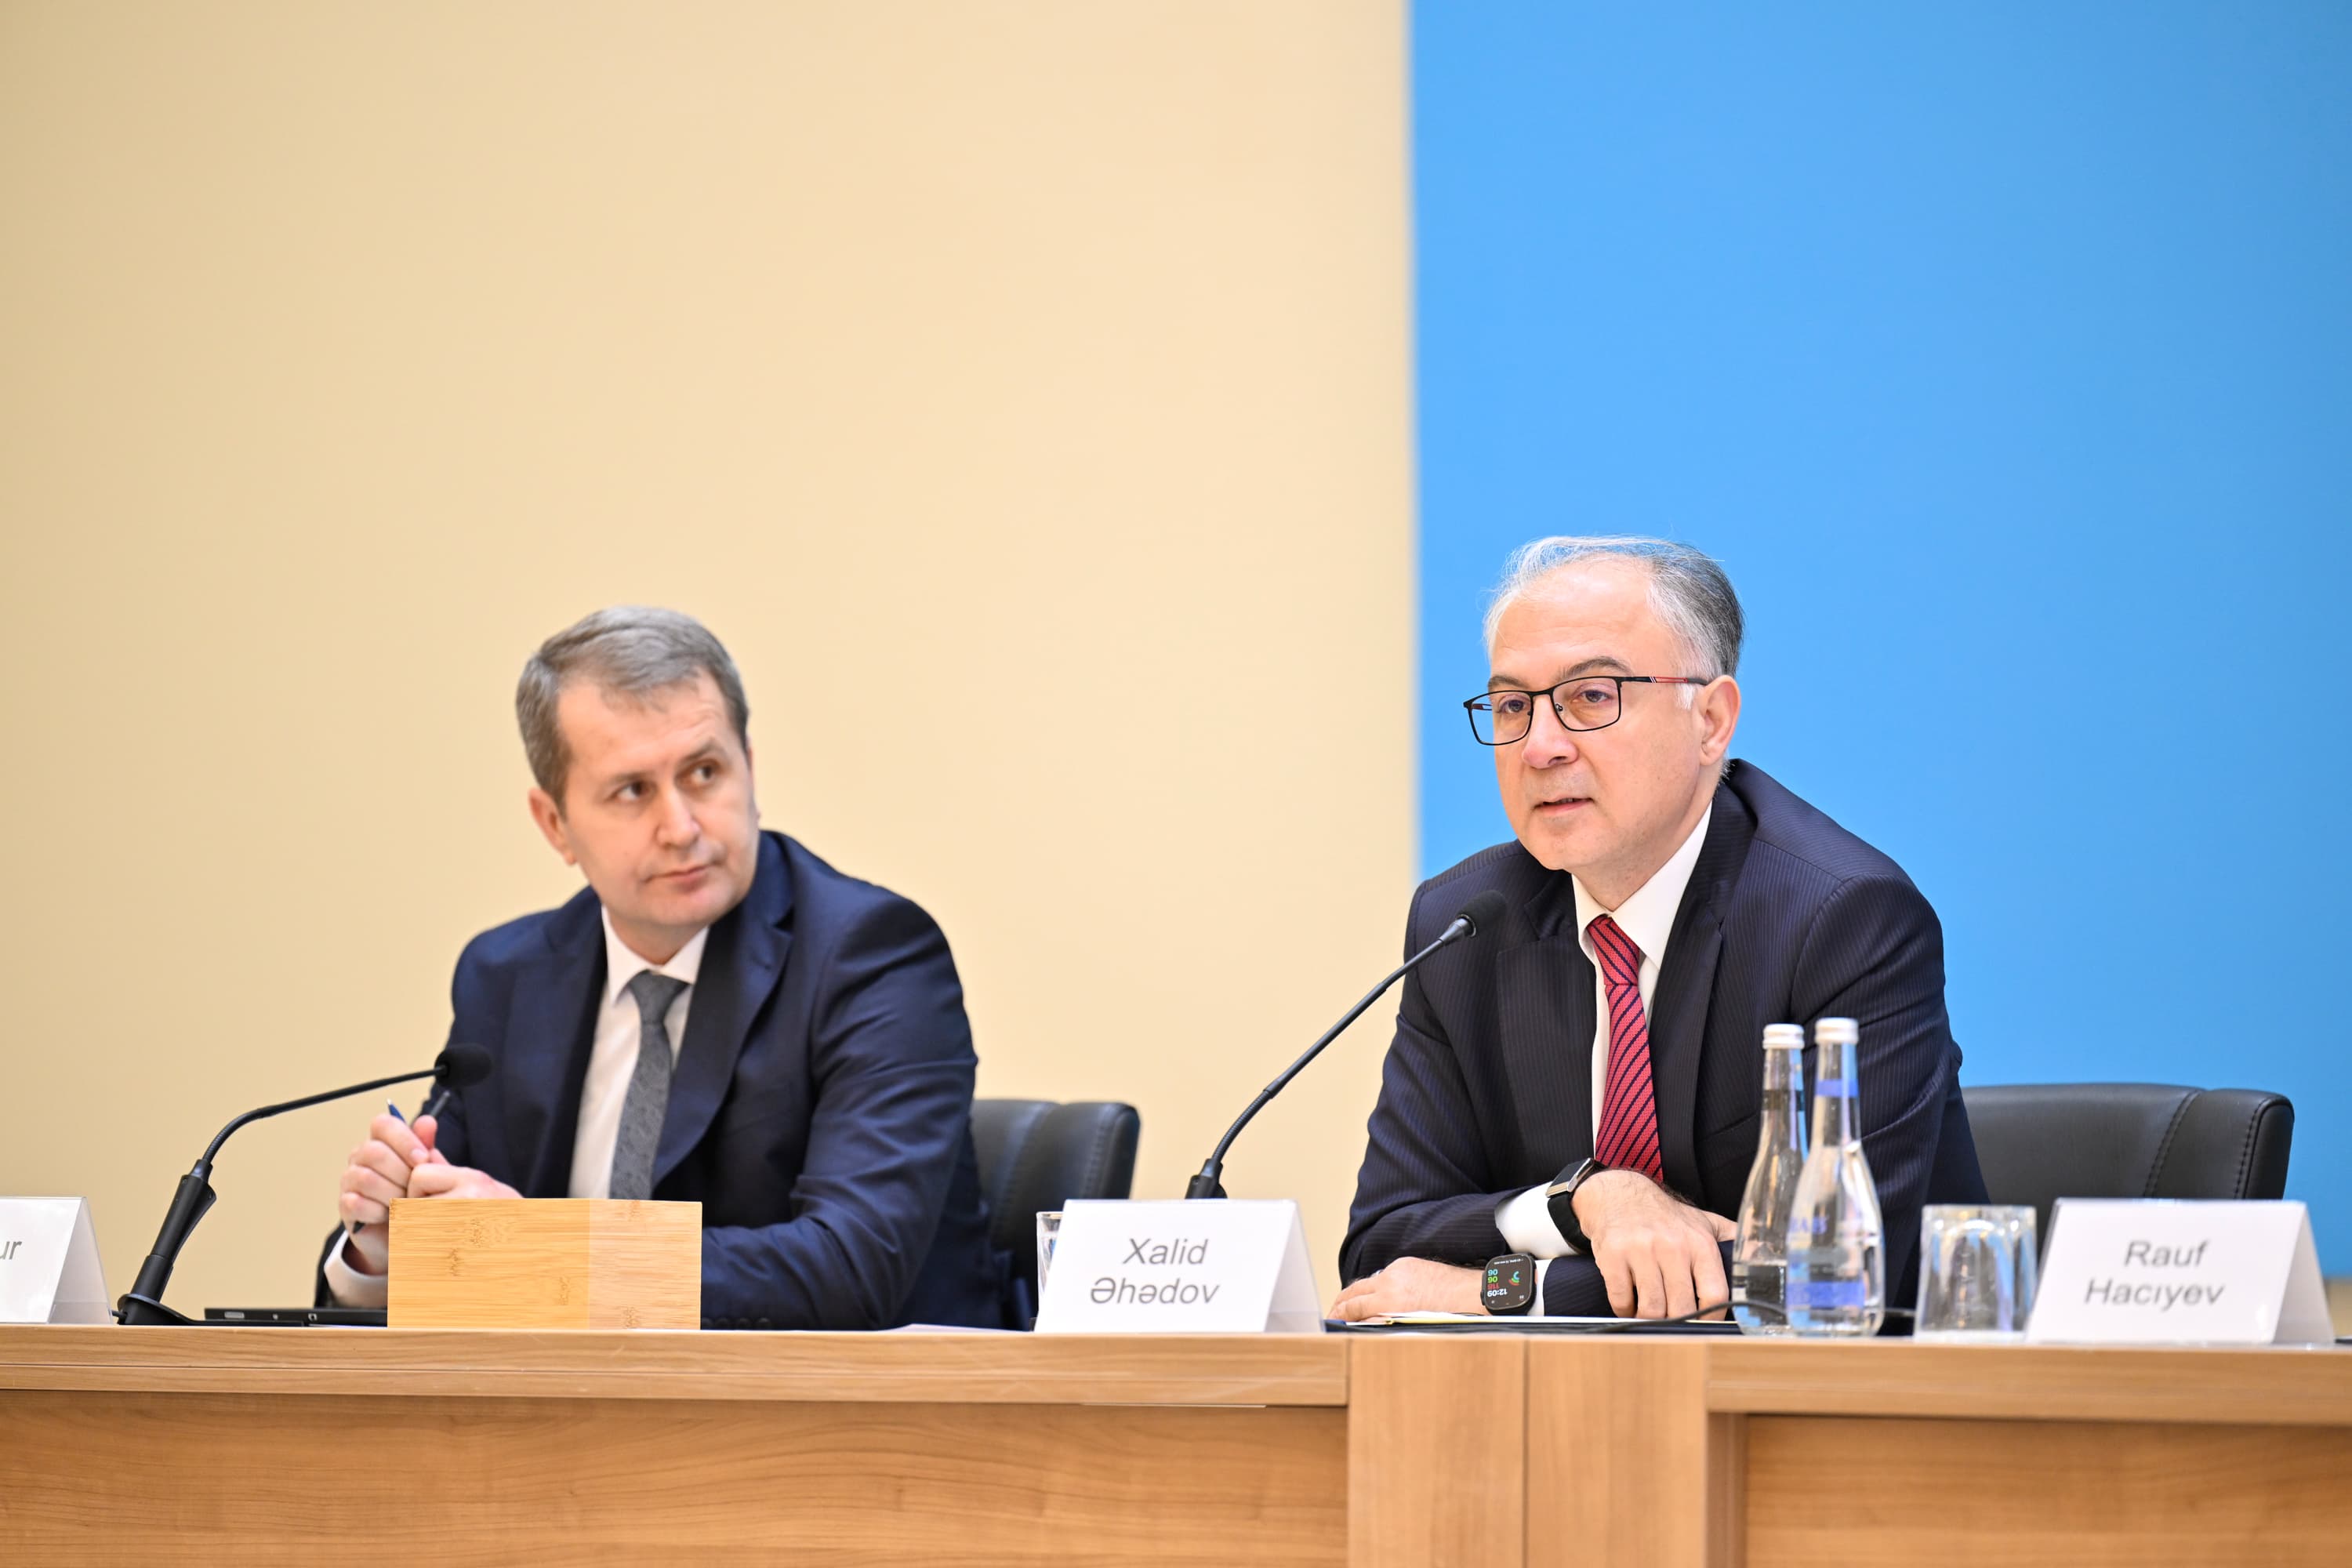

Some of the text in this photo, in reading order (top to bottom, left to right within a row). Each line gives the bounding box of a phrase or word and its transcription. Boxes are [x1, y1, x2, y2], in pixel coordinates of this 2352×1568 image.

[1123, 1238, 1208, 1264] Xalid
[2124, 1240, 2209, 1267] Rauf
[1091, 1277, 1219, 1305] Əhədov
[1487, 1288, 1507, 1297] 12:09
